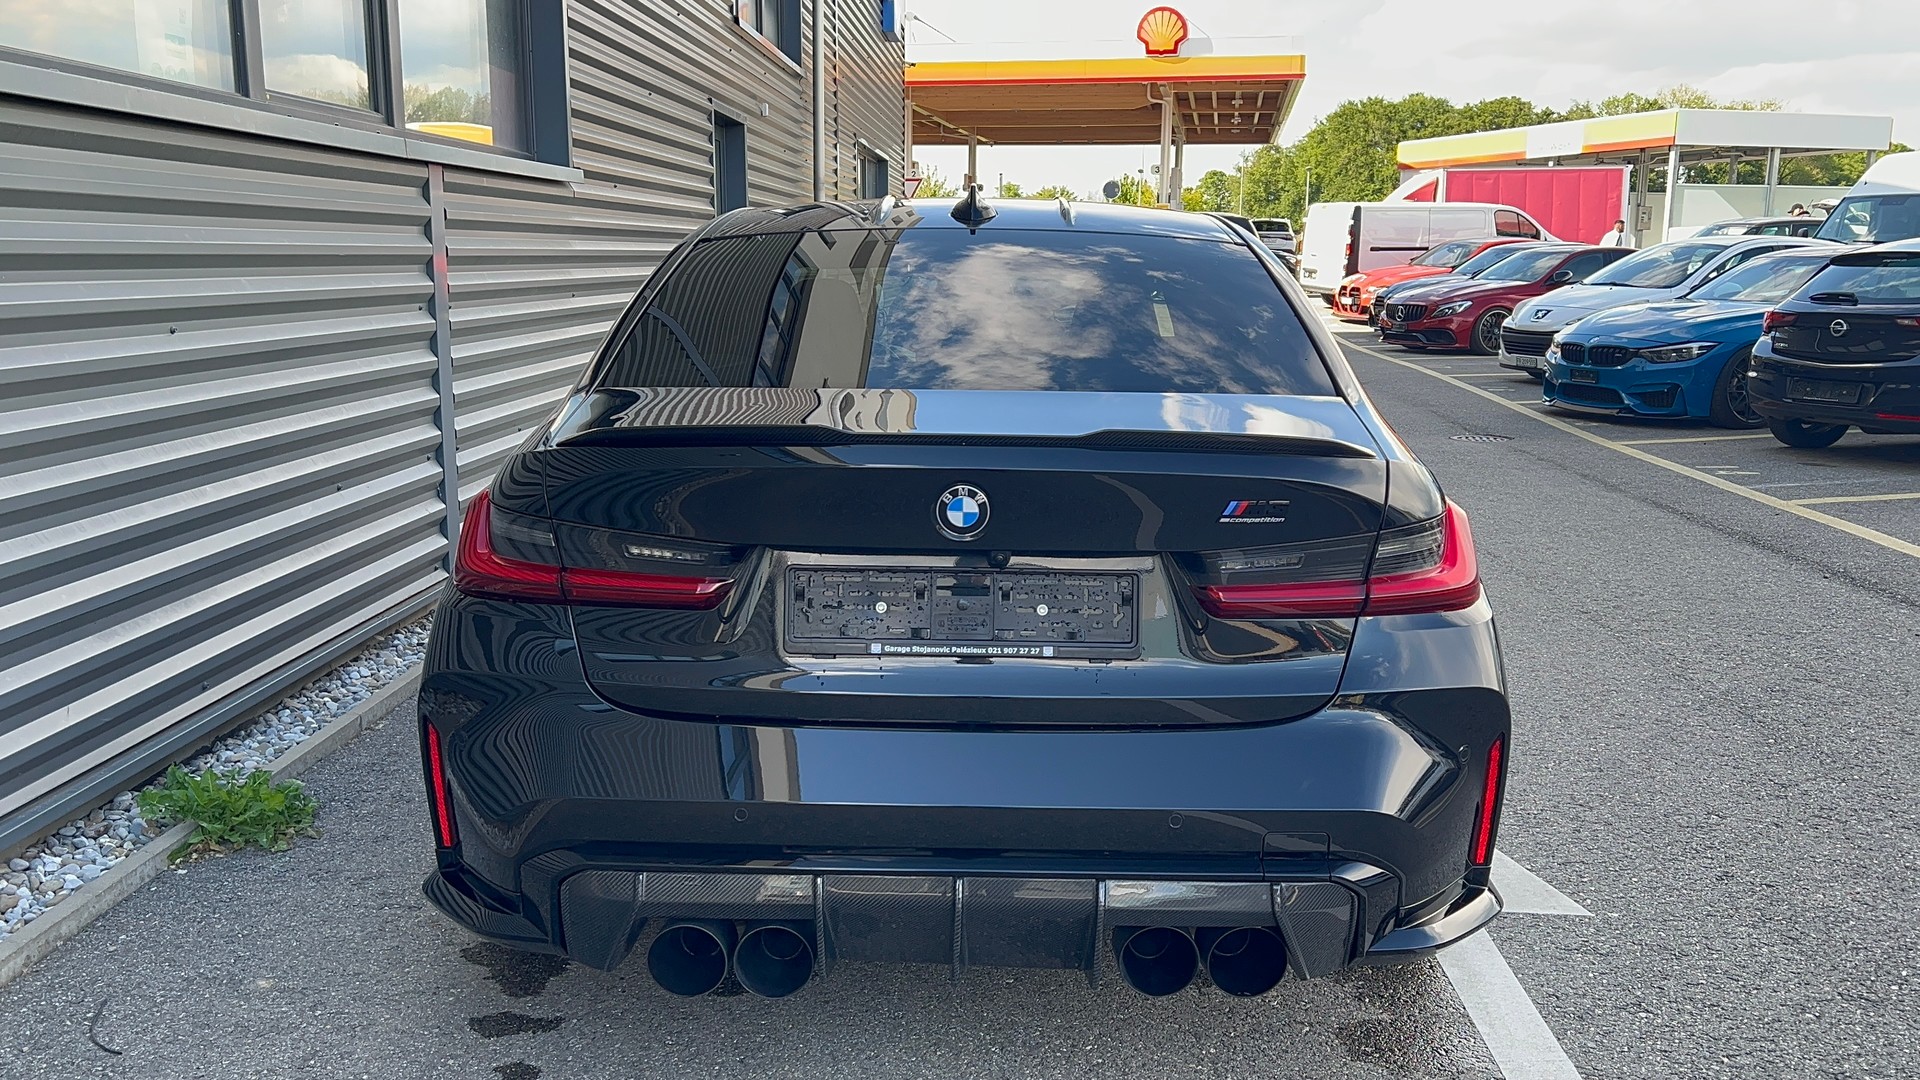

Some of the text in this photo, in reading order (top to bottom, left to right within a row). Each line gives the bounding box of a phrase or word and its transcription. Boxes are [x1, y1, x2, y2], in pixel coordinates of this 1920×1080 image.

[1154, 165, 1160, 174] 3
[942, 487, 986, 505] BMW
[1229, 516, 1286, 524] competition
[884, 645, 911, 653] Garage
[912, 645, 950, 654] Stojanovic
[951, 646, 987, 654] Palézieux
[1030, 647, 1040, 655] 27
